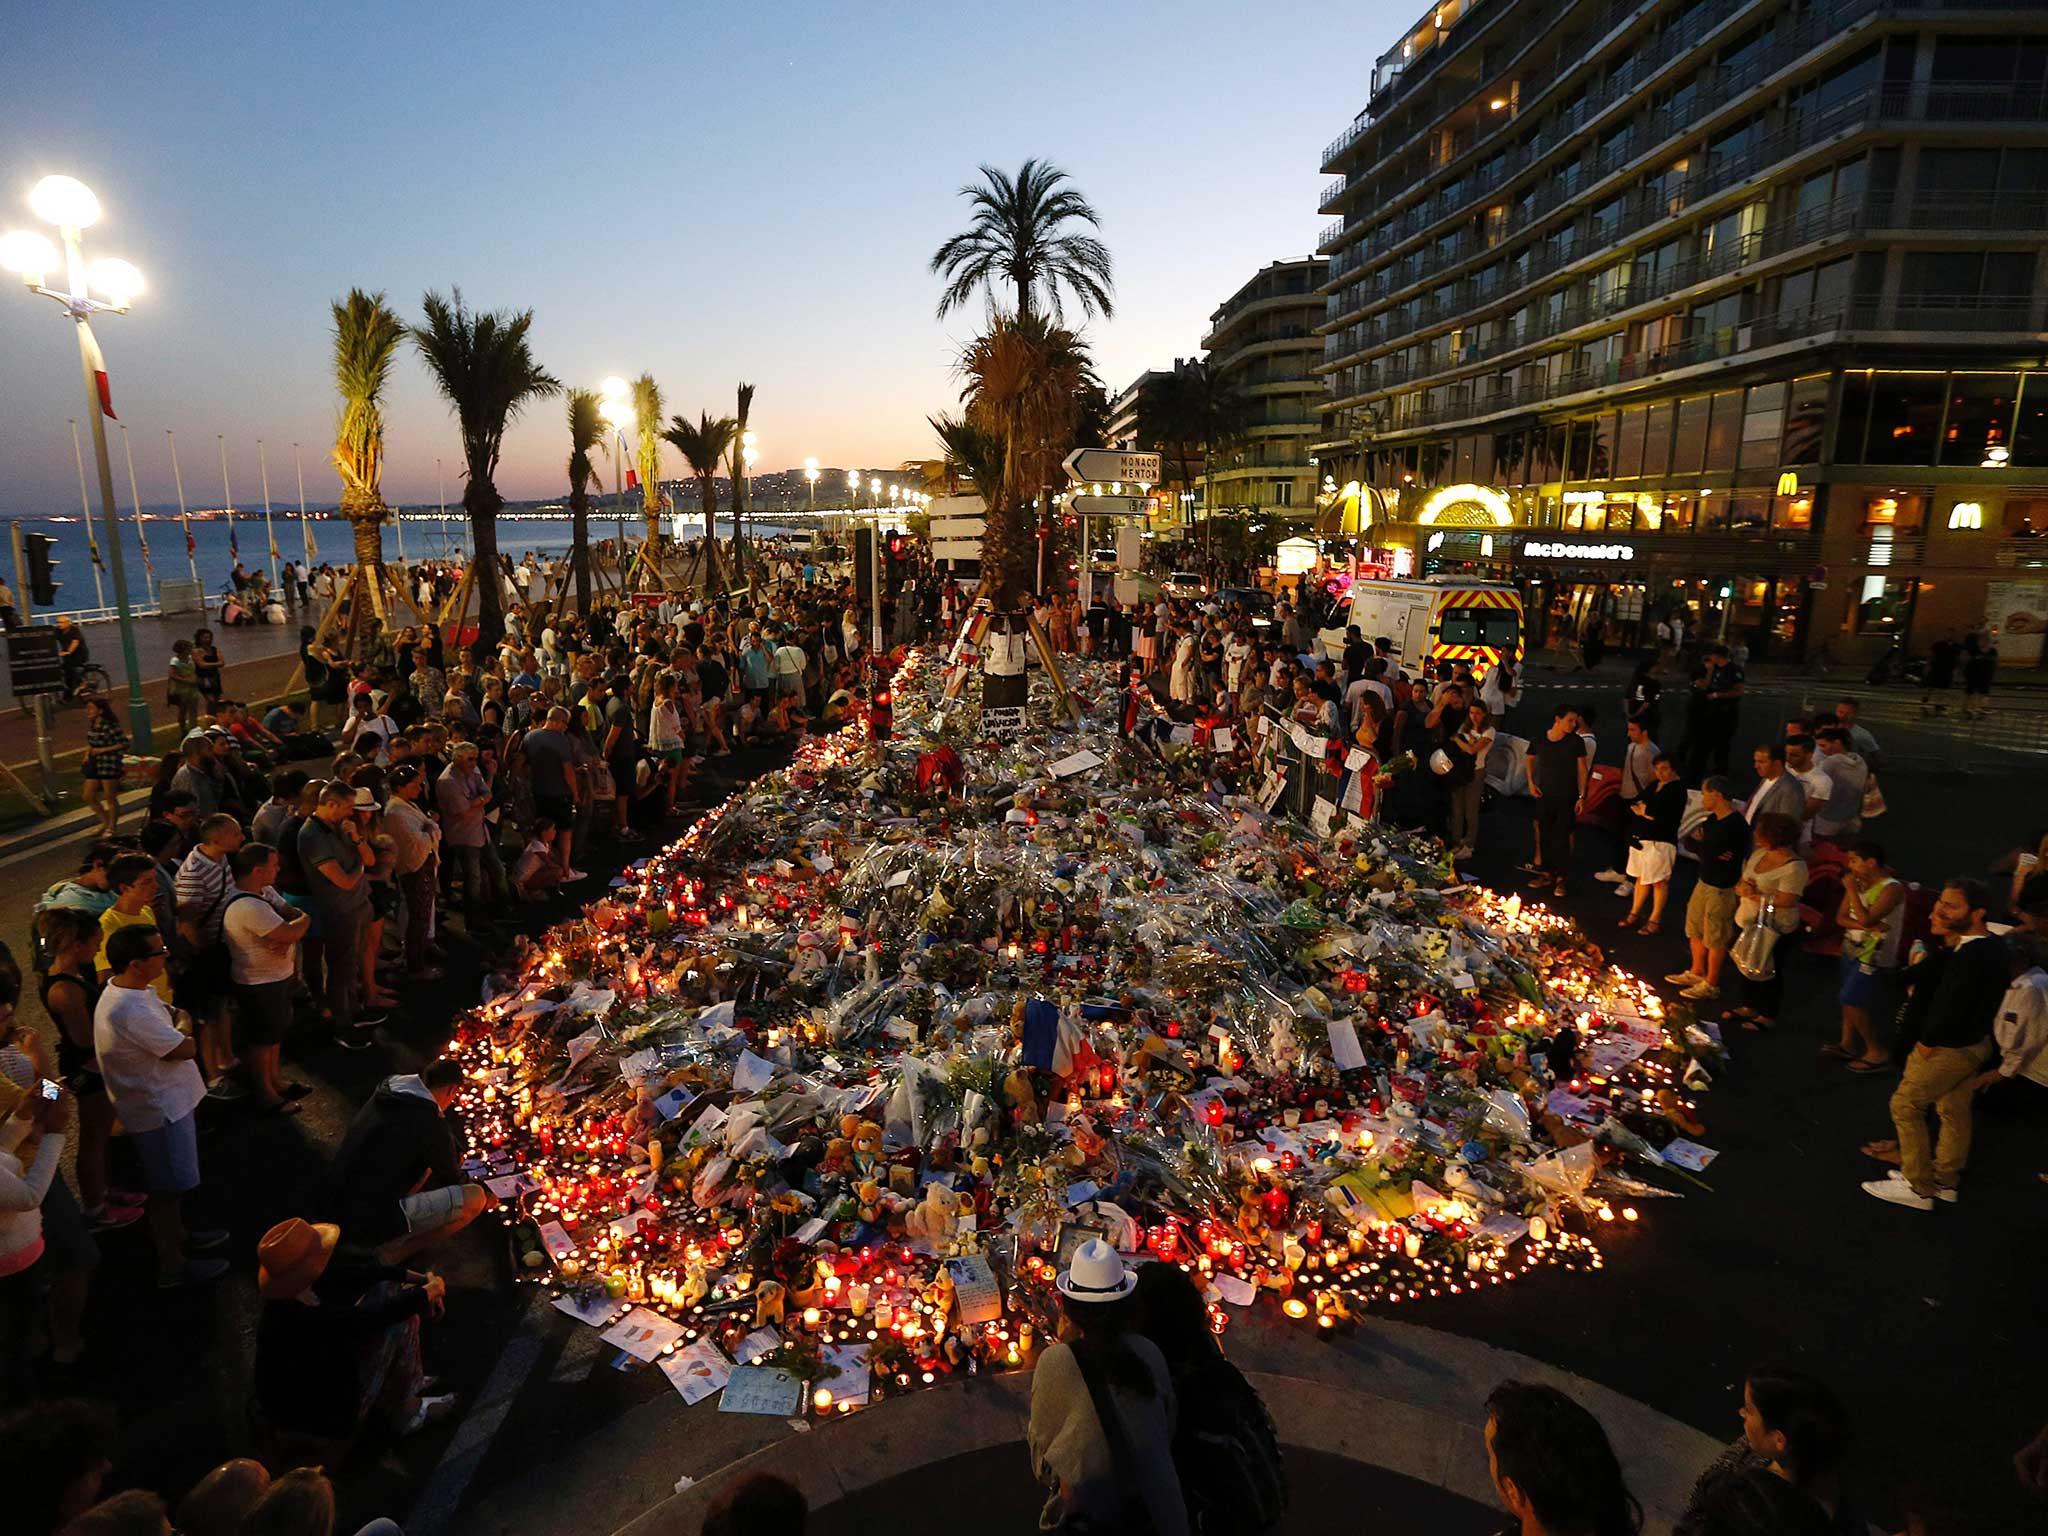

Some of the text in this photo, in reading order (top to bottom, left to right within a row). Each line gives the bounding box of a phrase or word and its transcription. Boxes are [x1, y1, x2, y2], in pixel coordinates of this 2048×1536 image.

[1120, 457, 1158, 467] MONACO
[1120, 468, 1158, 479] MENTON
[1523, 542, 1635, 561] McDonald's
